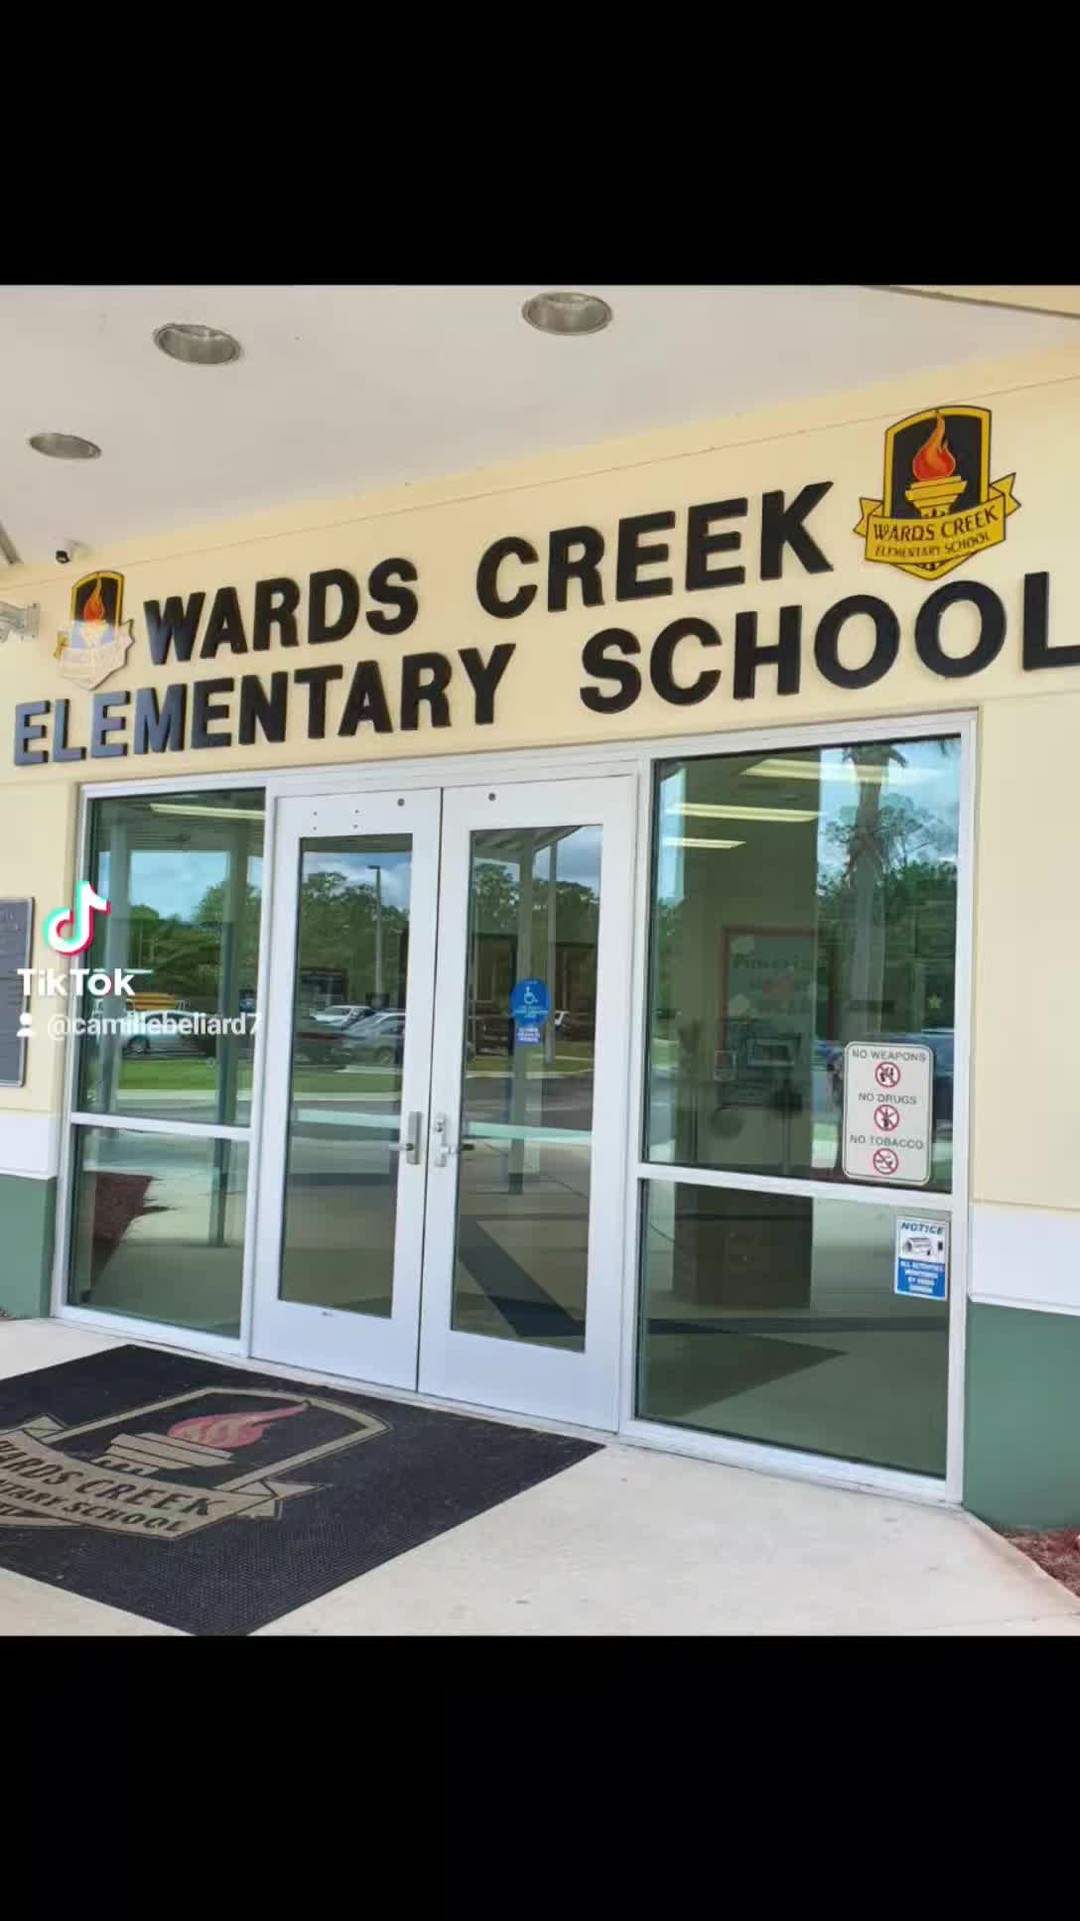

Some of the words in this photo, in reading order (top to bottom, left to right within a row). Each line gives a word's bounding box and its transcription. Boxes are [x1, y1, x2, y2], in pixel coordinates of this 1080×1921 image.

[874, 523, 936, 542] WARDS
[940, 504, 999, 539] CREEK
[874, 545, 940, 558] ELEMENTARY
[944, 532, 991, 555] SCHOOL
[143, 557, 419, 666] WARDS
[476, 481, 834, 619] CREEK
[14, 643, 516, 766] ELEMENTARY
[580, 571, 1080, 714] SCHOOL
[852, 1049, 867, 1059] NO
[871, 1049, 926, 1063] WEAPONS
[858, 1092, 874, 1102] NO
[876, 1093, 917, 1105] DRUGS
[850, 1134, 866, 1144] NO
[870, 1135, 923, 1150] TOBACCO
[901, 1221, 944, 1235] NOTICE
[75, 1479, 226, 1516] CREEK
[62, 1502, 184, 1532] SCHOOL
